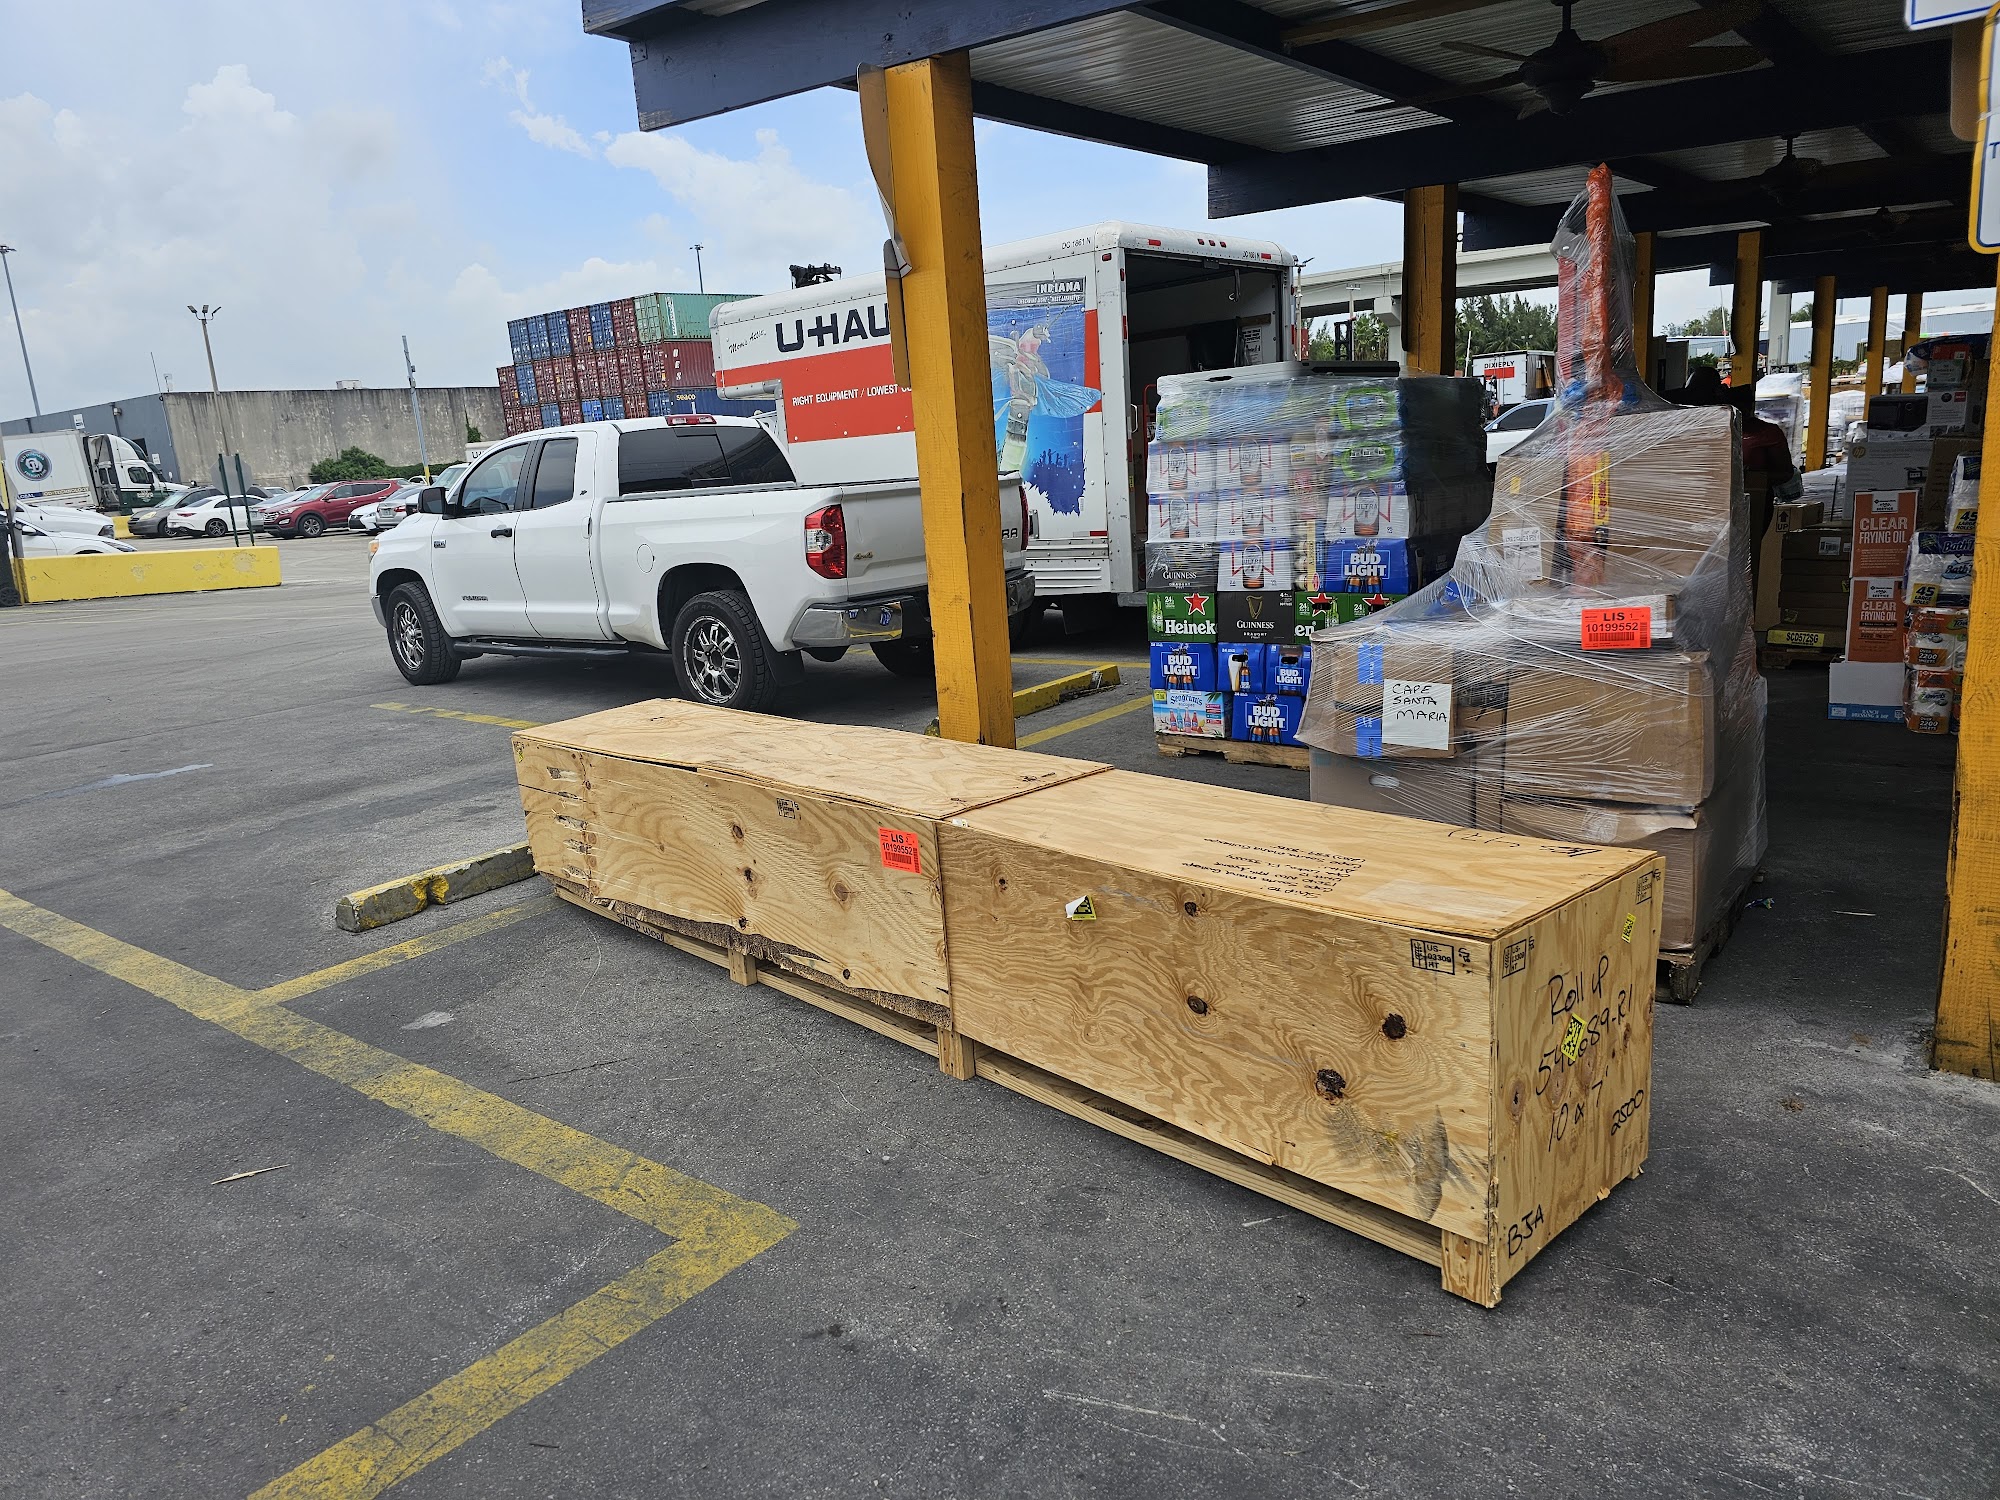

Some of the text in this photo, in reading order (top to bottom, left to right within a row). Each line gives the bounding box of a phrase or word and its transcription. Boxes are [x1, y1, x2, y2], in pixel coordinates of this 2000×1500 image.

[1036, 282, 1081, 294] INDIANA
[775, 303, 890, 353] U-HAU
[1484, 360, 1515, 369] DIXIEPLY
[792, 395, 814, 406] RIGHT
[816, 390, 859, 404] EQUIPMENT
[867, 383, 899, 397] LOWEST
[1960, 510, 1978, 521] 45
[1777, 523, 1789, 531] UP
[1860, 517, 1908, 531] CLEAR
[1859, 530, 1907, 544] FRYING OIL
[1943, 541, 1967, 553] Bath
[1350, 554, 1381, 565] BUD
[1163, 571, 1197, 579] GUINNESS
[1344, 564, 1387, 577] LIGHT
[1915, 586, 1935, 596] 45
[1299, 602, 1307, 611] 24
[1354, 603, 1362, 611] 24
[1861, 601, 1897, 611] CLEAR
[1603, 612, 1625, 622] LIS
[1860, 611, 1897, 621] FRYING OIL
[1236, 620, 1274, 630] GUINNESS
[1585, 622, 1639, 632] 10199552
[1167, 654, 1193, 665] BUD
[1163, 664, 1198, 676] LIGHT
[1280, 668, 1299, 676] BUD
[1276, 676, 1303, 684] LIGHT
[1392, 683, 1431, 695] CAPE
[1170, 694, 1202, 706] Seagram's
[1392, 695, 1437, 706] SANTA
[1252, 705, 1281, 718] BUD
[1396, 709, 1448, 723] MARIA
[1247, 715, 1286, 728] LIGHT
[890, 833, 904, 844] LIS
[882, 842, 913, 856] 10199552
[1426, 944, 1442, 952] US-
[1426, 953, 1452, 963] 03309
[1428, 961, 1440, 969] HT
[1547, 970, 1585, 1025] Roll
[1508, 1203, 1545, 1259] BJA
